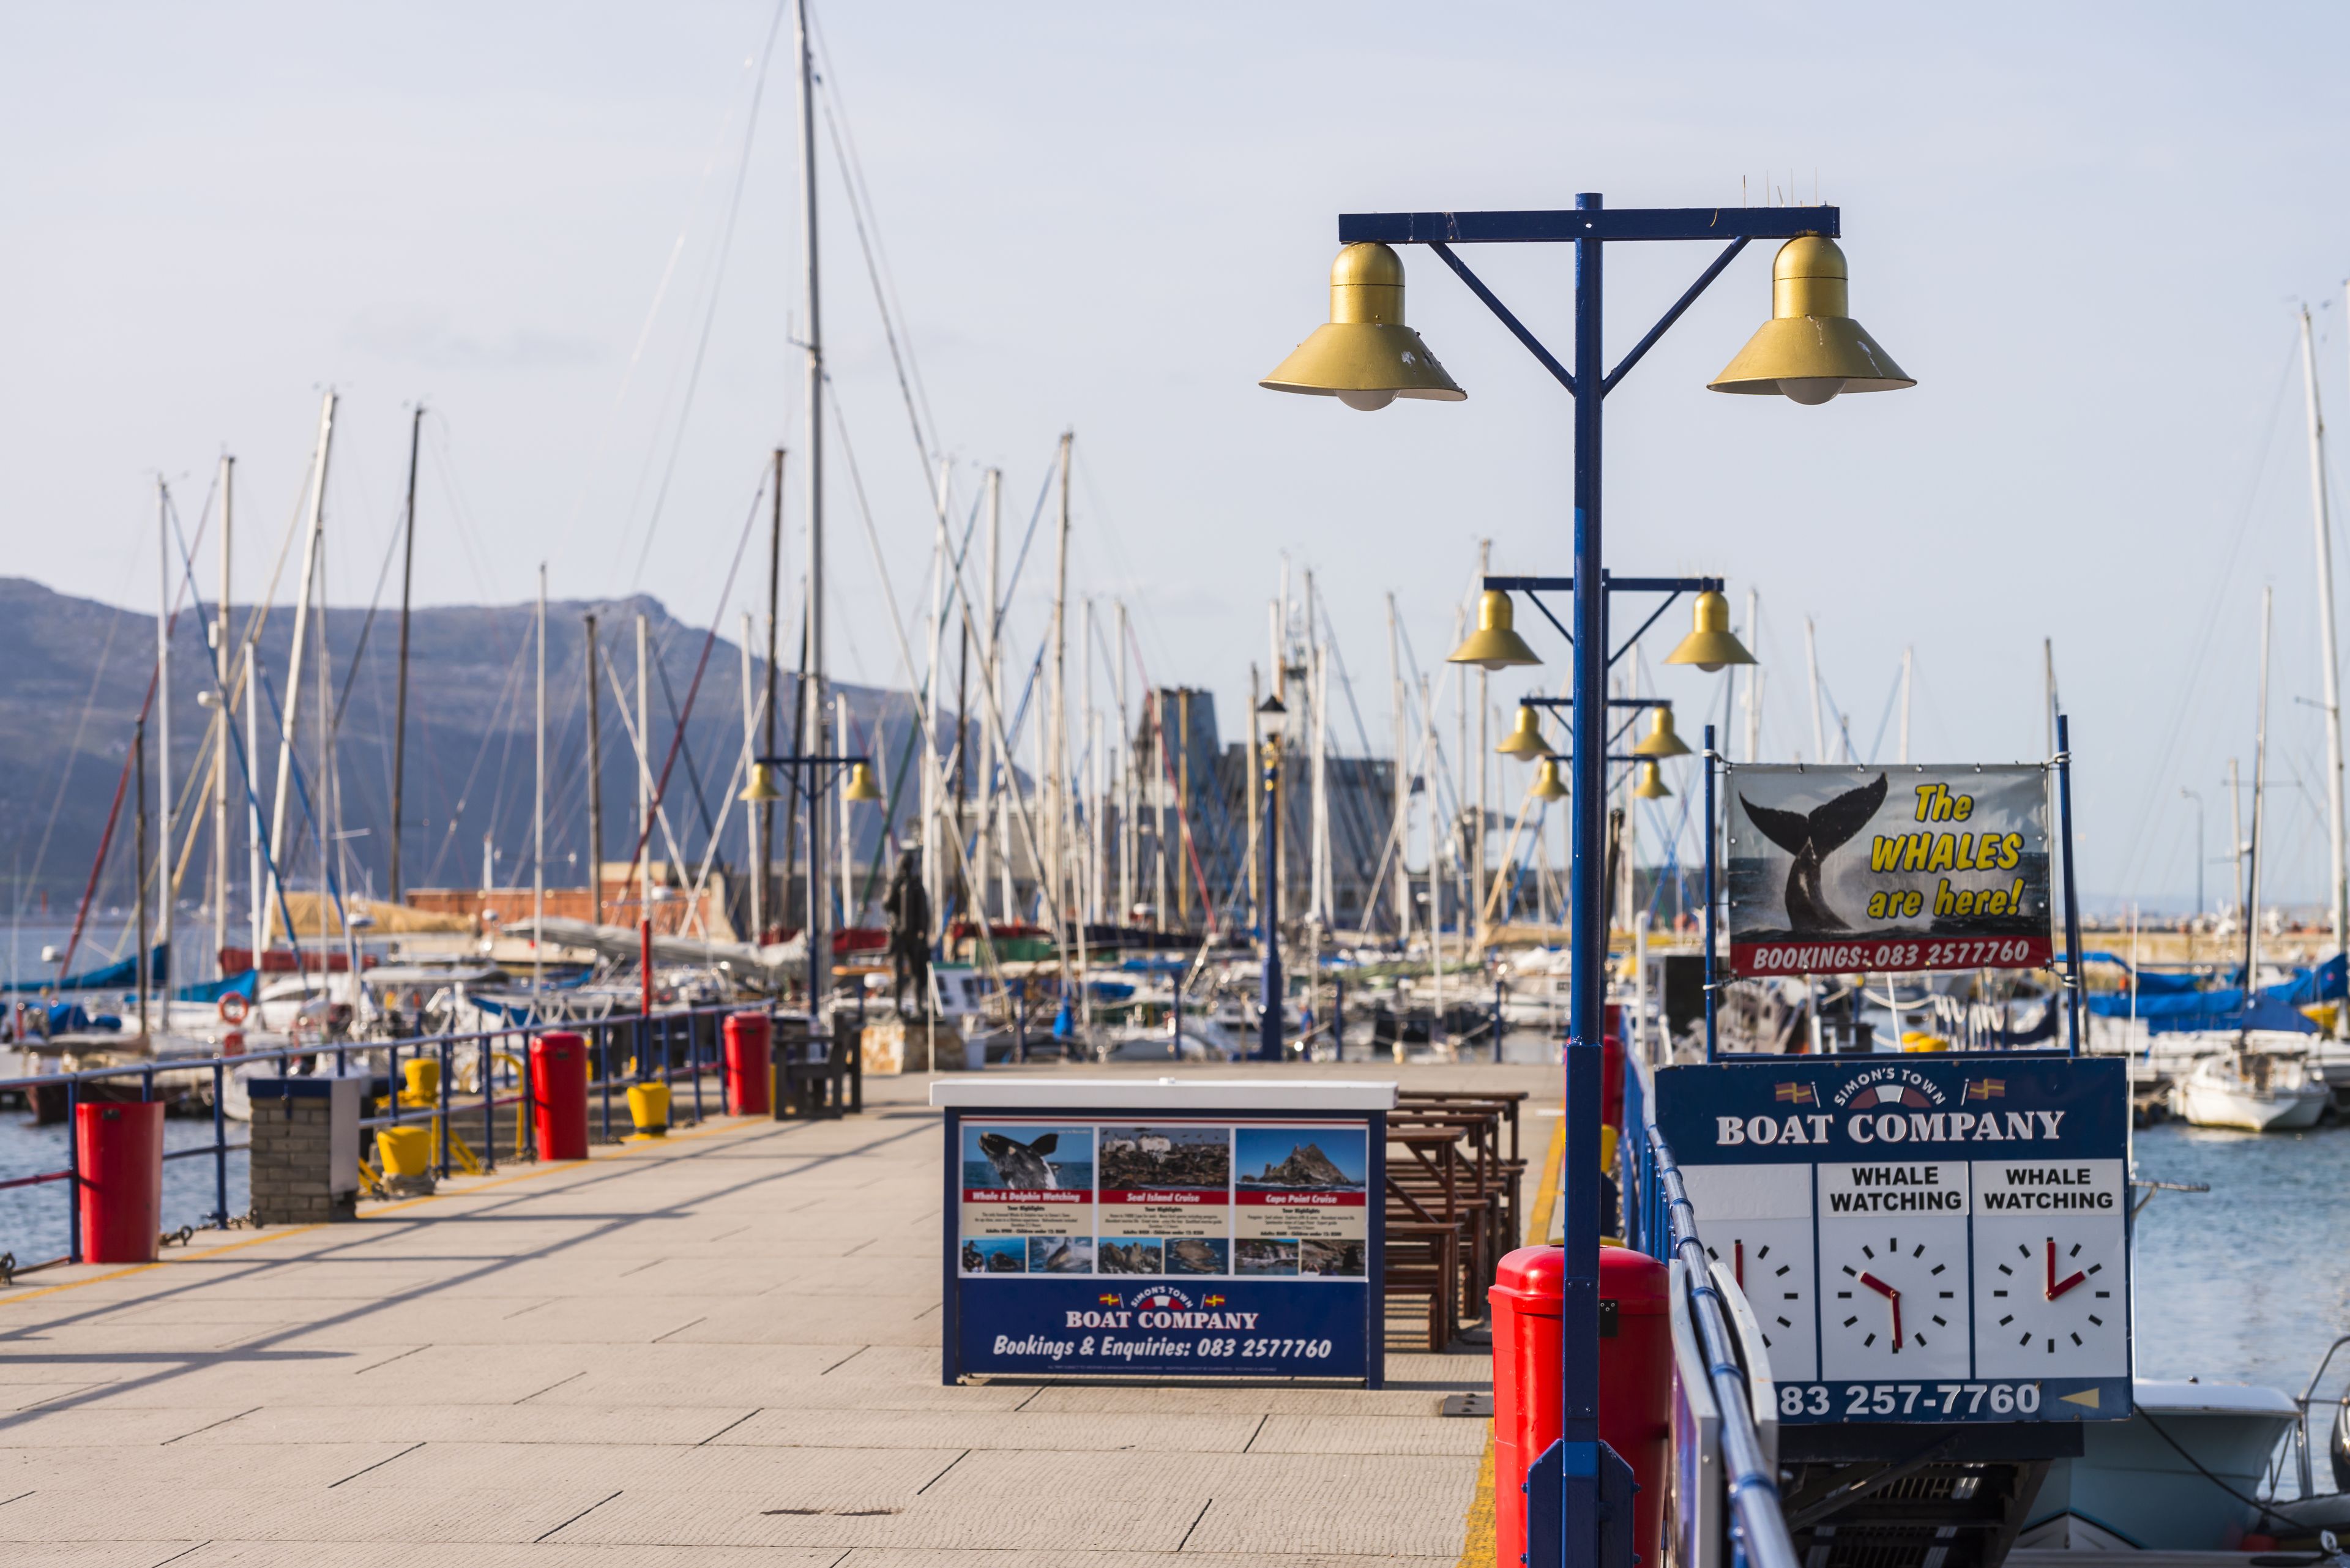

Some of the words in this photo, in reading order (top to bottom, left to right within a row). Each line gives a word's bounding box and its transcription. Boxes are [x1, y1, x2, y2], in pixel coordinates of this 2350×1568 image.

[1915, 783, 1973, 822] The
[1870, 832, 2023, 872] WHALES
[1867, 890, 1923, 917] are
[1933, 878, 2025, 916] here!
[1753, 946, 1870, 970] BOOKINGS:
[1876, 944, 1918, 968] 083
[1928, 941, 2029, 965] 2577760
[1835, 1067, 1895, 1107] SIMON'S
[1901, 1069, 1946, 1105] TOWN
[1715, 1114, 1833, 1144] BOAT
[1847, 1111, 2065, 1143] COMPANY
[1852, 1167, 1939, 1185] WHALE
[2005, 1168, 2091, 1185] WHALE
[972, 1191, 999, 1201] Whale
[1000, 1192, 1007, 1200] &
[1009, 1192, 1041, 1203] Dolphin
[1042, 1192, 1081, 1203] Watching
[1127, 1193, 1146, 1202] Seal
[1147, 1193, 1173, 1202] Island
[1174, 1193, 1200, 1203] Cruise
[1266, 1194, 1286, 1204] Cape
[1288, 1194, 1310, 1203] Point
[1311, 1195, 1337, 1204] Cruise
[1830, 1191, 1962, 1212] WATCHING
[1984, 1192, 2113, 1209] WATCHING
[1130, 1286, 1165, 1308] SIMON'S
[1168, 1287, 1194, 1308] TOWN
[1066, 1311, 1132, 1328] BOAT
[1138, 1312, 1259, 1329] COMPANY
[993, 1334, 1075, 1361] Bookings
[1079, 1335, 1095, 1356] &
[1100, 1336, 1192, 1361] Enquiries:
[1197, 1338, 1236, 1357] 083
[1242, 1338, 1332, 1358] 2577760
[1775, 1386, 1830, 1415] 83
[1845, 1384, 2040, 1414] 257-7760
